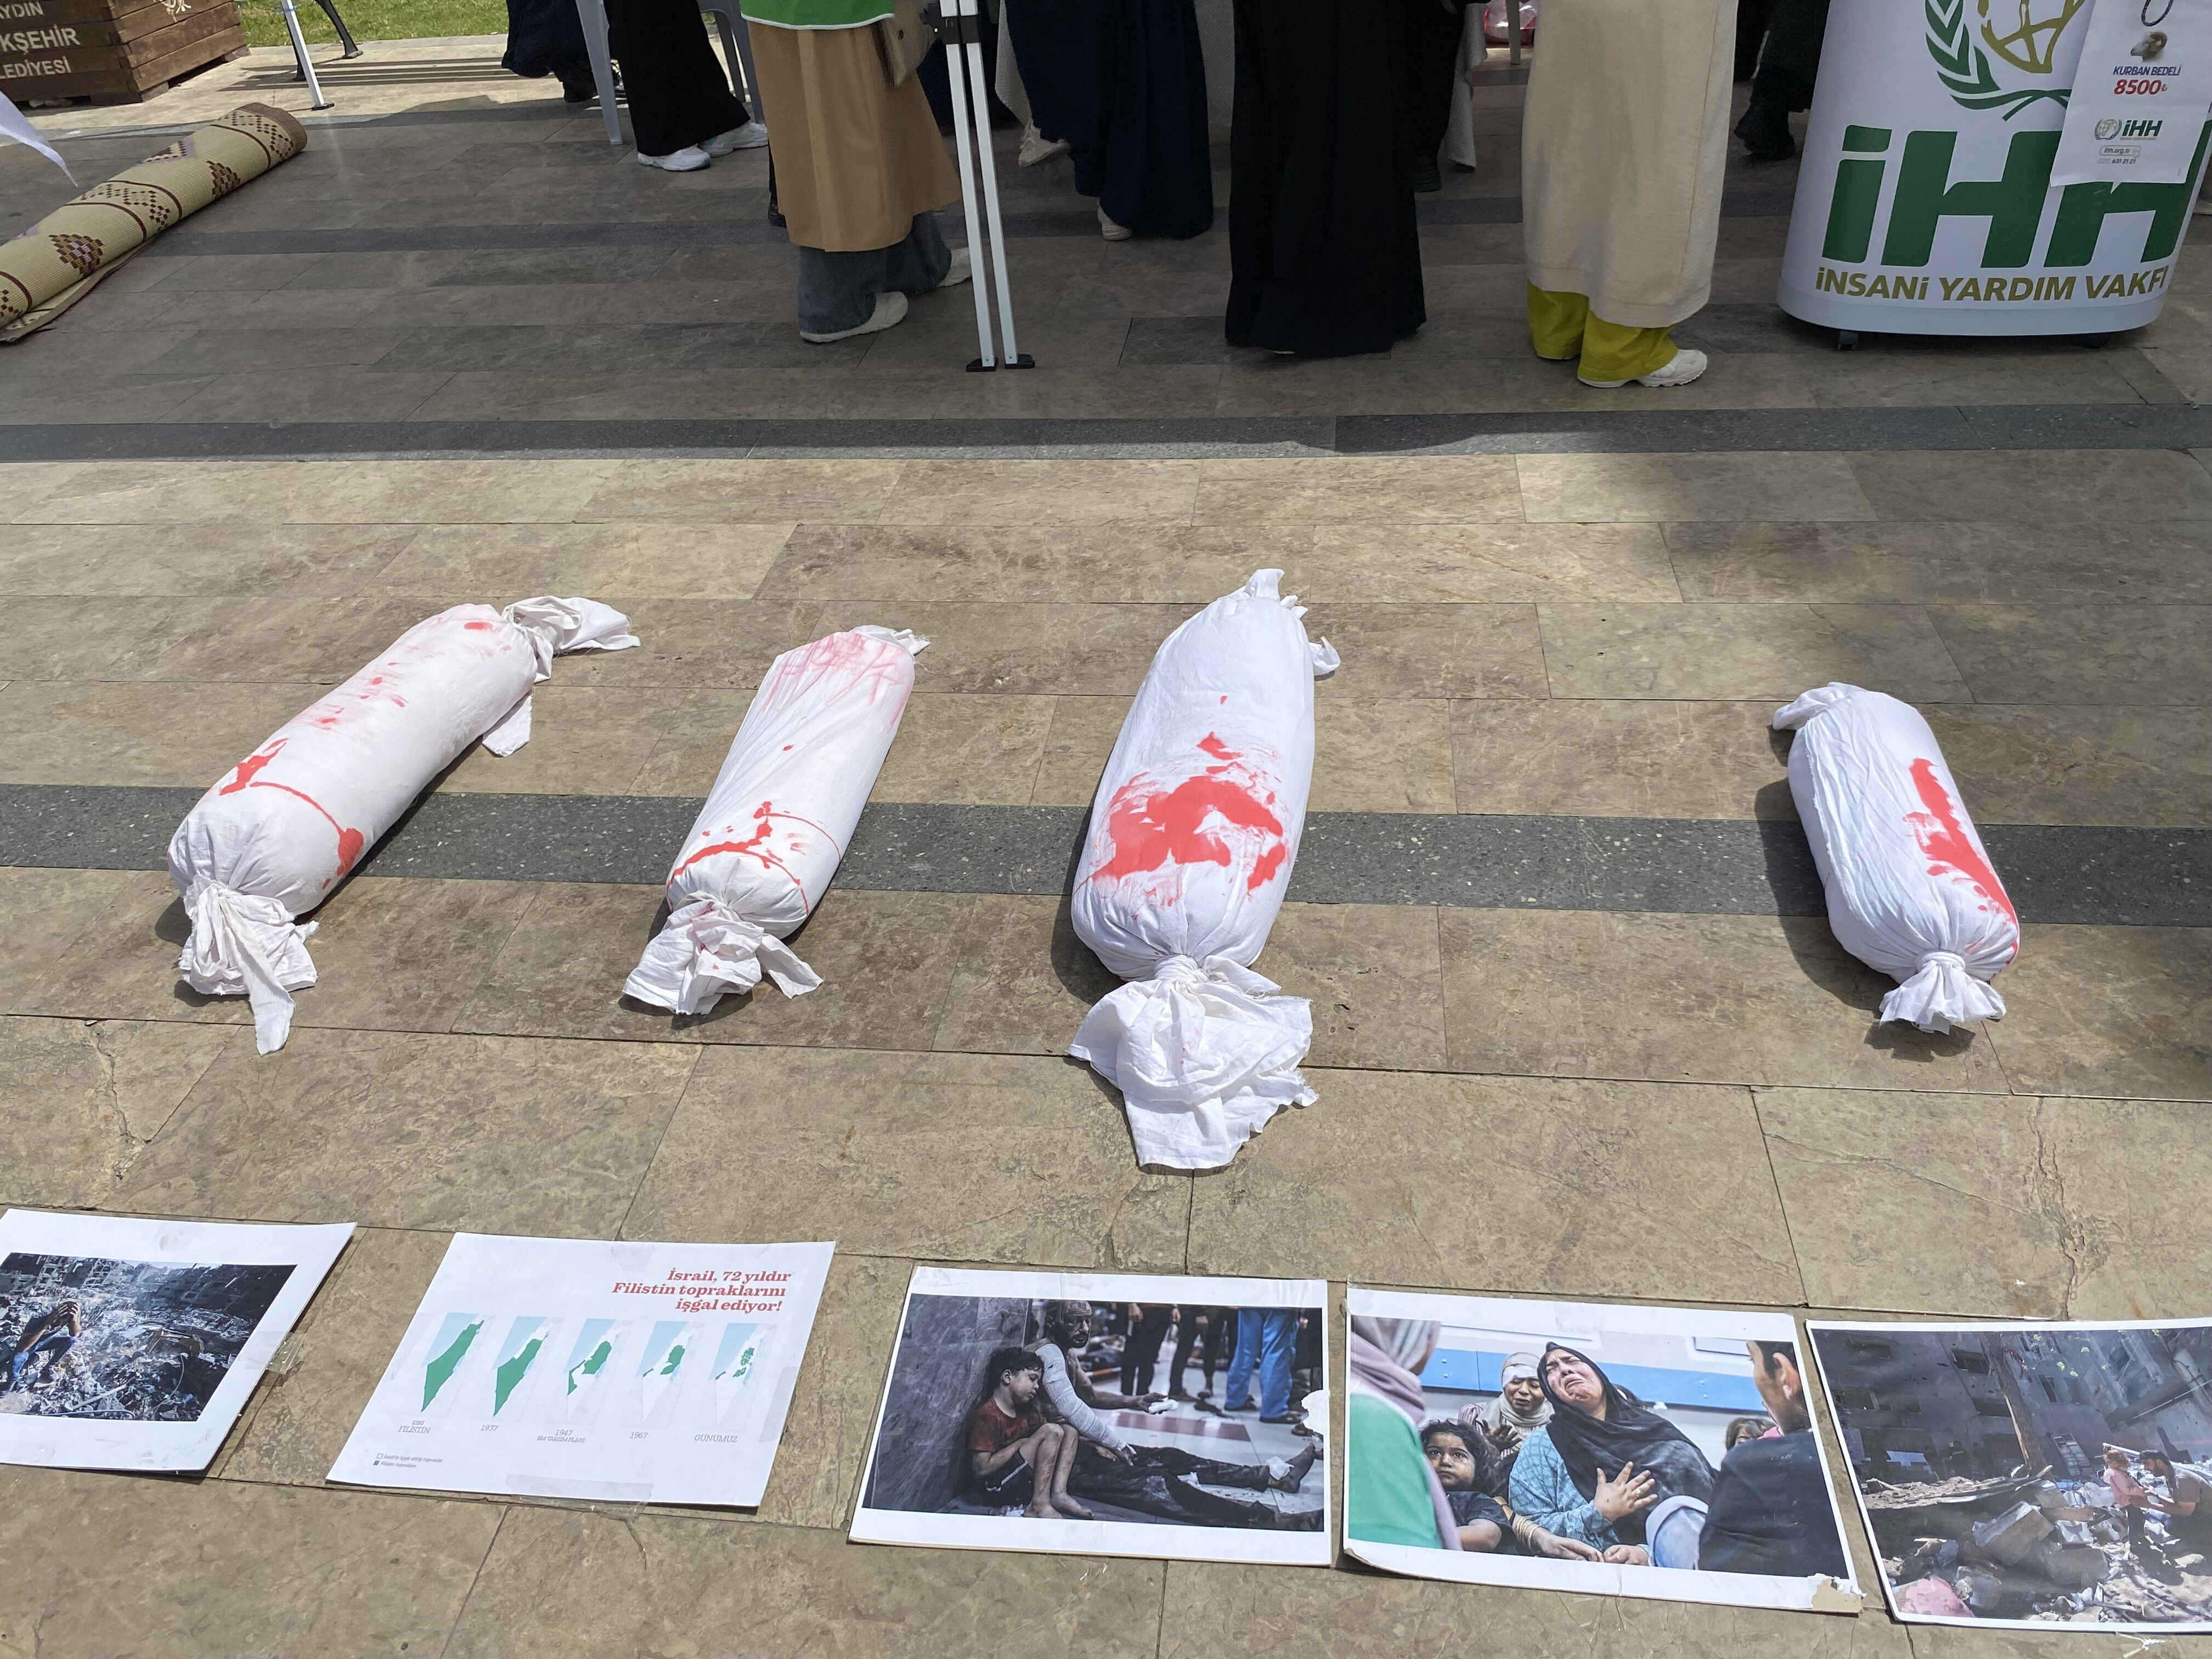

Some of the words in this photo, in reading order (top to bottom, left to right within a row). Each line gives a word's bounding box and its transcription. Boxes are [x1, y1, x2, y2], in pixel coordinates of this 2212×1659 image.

[2113, 66, 2149, 76] KURBAN
[2151, 64, 2182, 76] BEDELİ
[1939, 276, 2077, 301] YARDIM
[2085, 266, 2169, 300] VAKFI
[667, 1267, 718, 1283] İsrail,
[723, 1271, 741, 1282] 72
[743, 1271, 791, 1284] yıldır
[612, 1283, 675, 1295] Filistin
[679, 1284, 786, 1298] topraklarını
[675, 1298, 719, 1313] işgal
[721, 1300, 783, 1313] ediyor!
